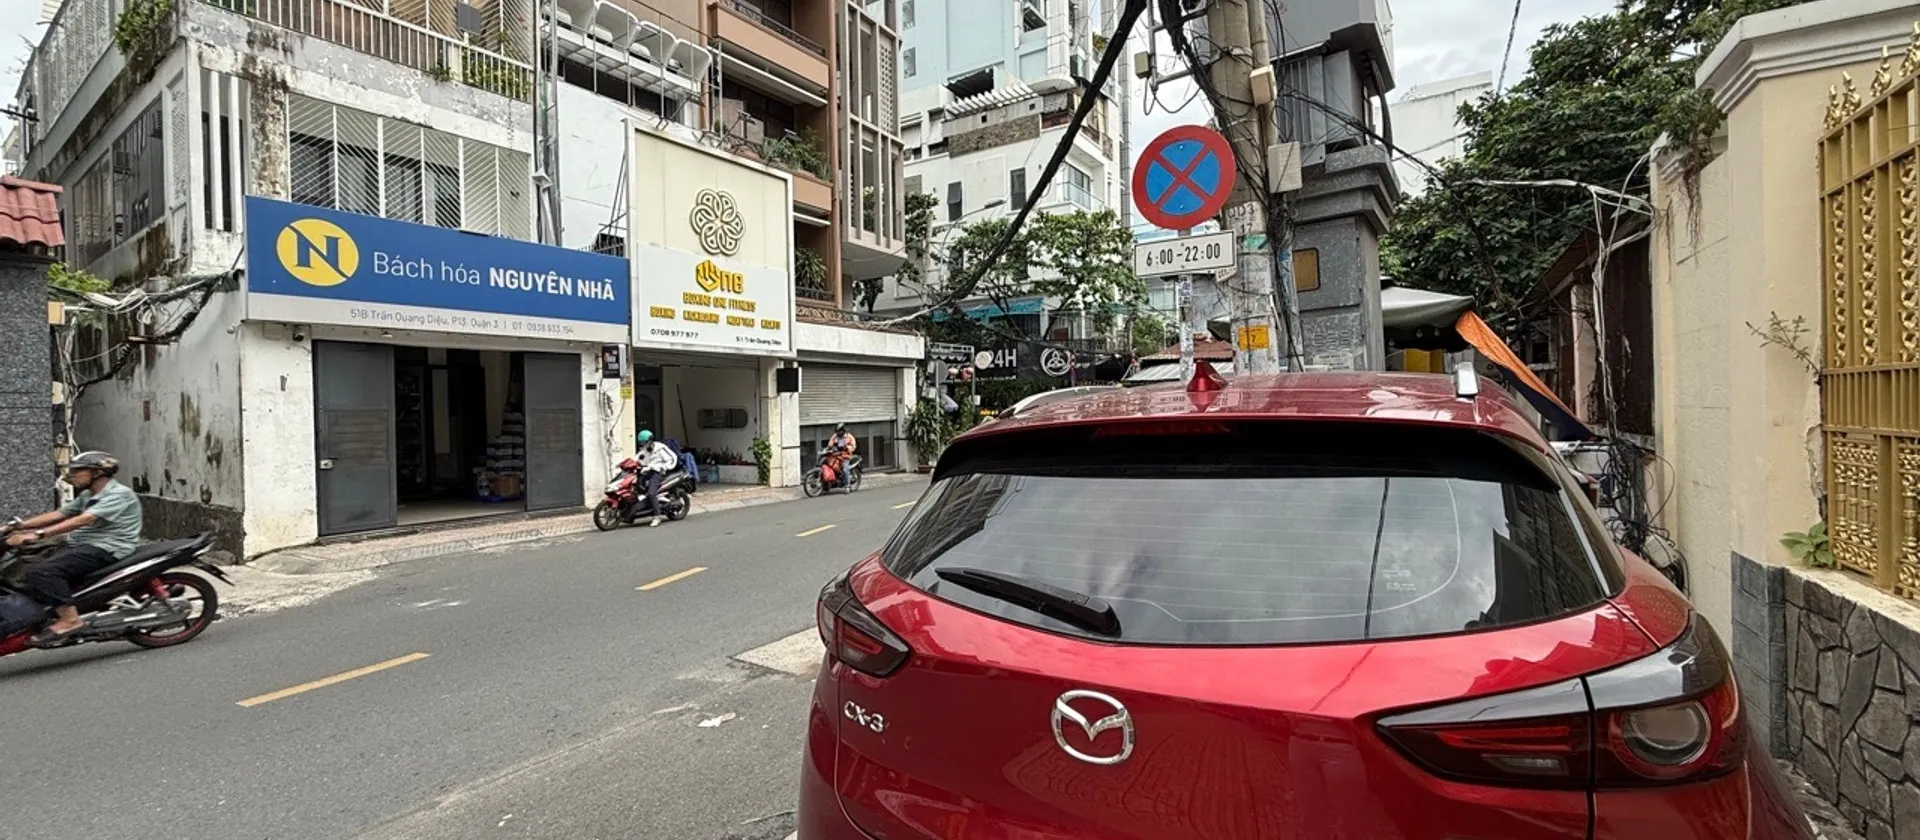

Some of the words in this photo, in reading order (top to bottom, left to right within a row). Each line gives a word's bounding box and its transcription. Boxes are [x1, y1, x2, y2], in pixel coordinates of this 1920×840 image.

[373, 251, 433, 281] Bách
[440, 260, 481, 286] hóa
[488, 267, 573, 296] NGUYÊN
[576, 276, 615, 302] NHÃ
[350, 308, 368, 319] 51B
[395, 312, 425, 325] Quang
[844, 700, 884, 733] CX-3
